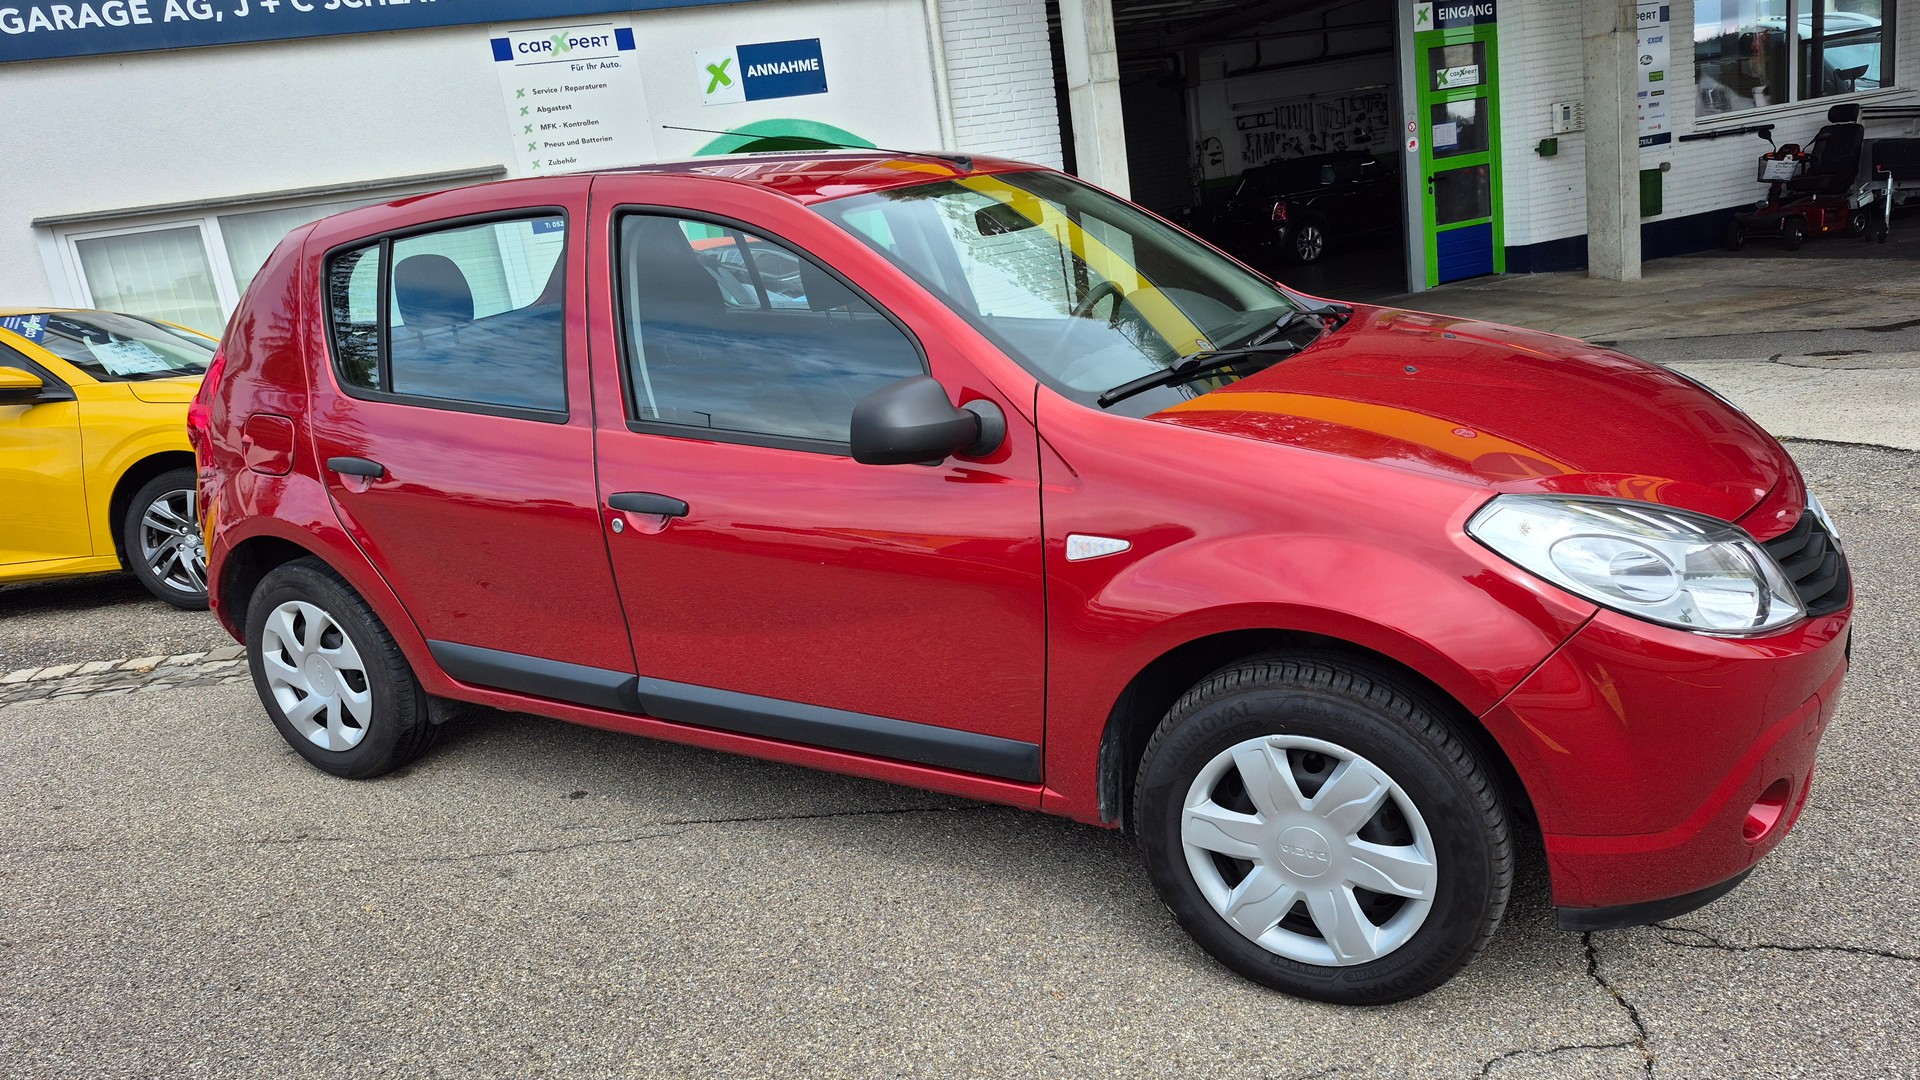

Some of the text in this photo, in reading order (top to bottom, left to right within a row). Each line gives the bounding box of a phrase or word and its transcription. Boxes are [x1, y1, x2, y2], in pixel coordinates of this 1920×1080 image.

[0, 0, 153, 35] GARAGE
[163, 0, 223, 23] AG,
[1438, 3, 1493, 20] EINGANG
[570, 61, 622, 72] Für Ihr Auto.
[747, 58, 820, 78] ANNAHME
[532, 87, 558, 95] Service
[564, 83, 608, 92] Reparaturen
[536, 104, 572, 113] Abgastest
[540, 122, 557, 131] MFK
[562, 119, 600, 128] Kontrollen
[566, 138, 580, 146] und
[581, 135, 613, 144] Batterien
[548, 156, 577, 166] Zubehör
[551, 220, 565, 228] 052
[1291, 703, 1332, 719] Shark
[1335, 713, 1365, 732] Skin
[1161, 700, 1258, 768] UNIROYAL
[1279, 843, 1328, 863] DACIA
[1350, 967, 1382, 981] TYRE
